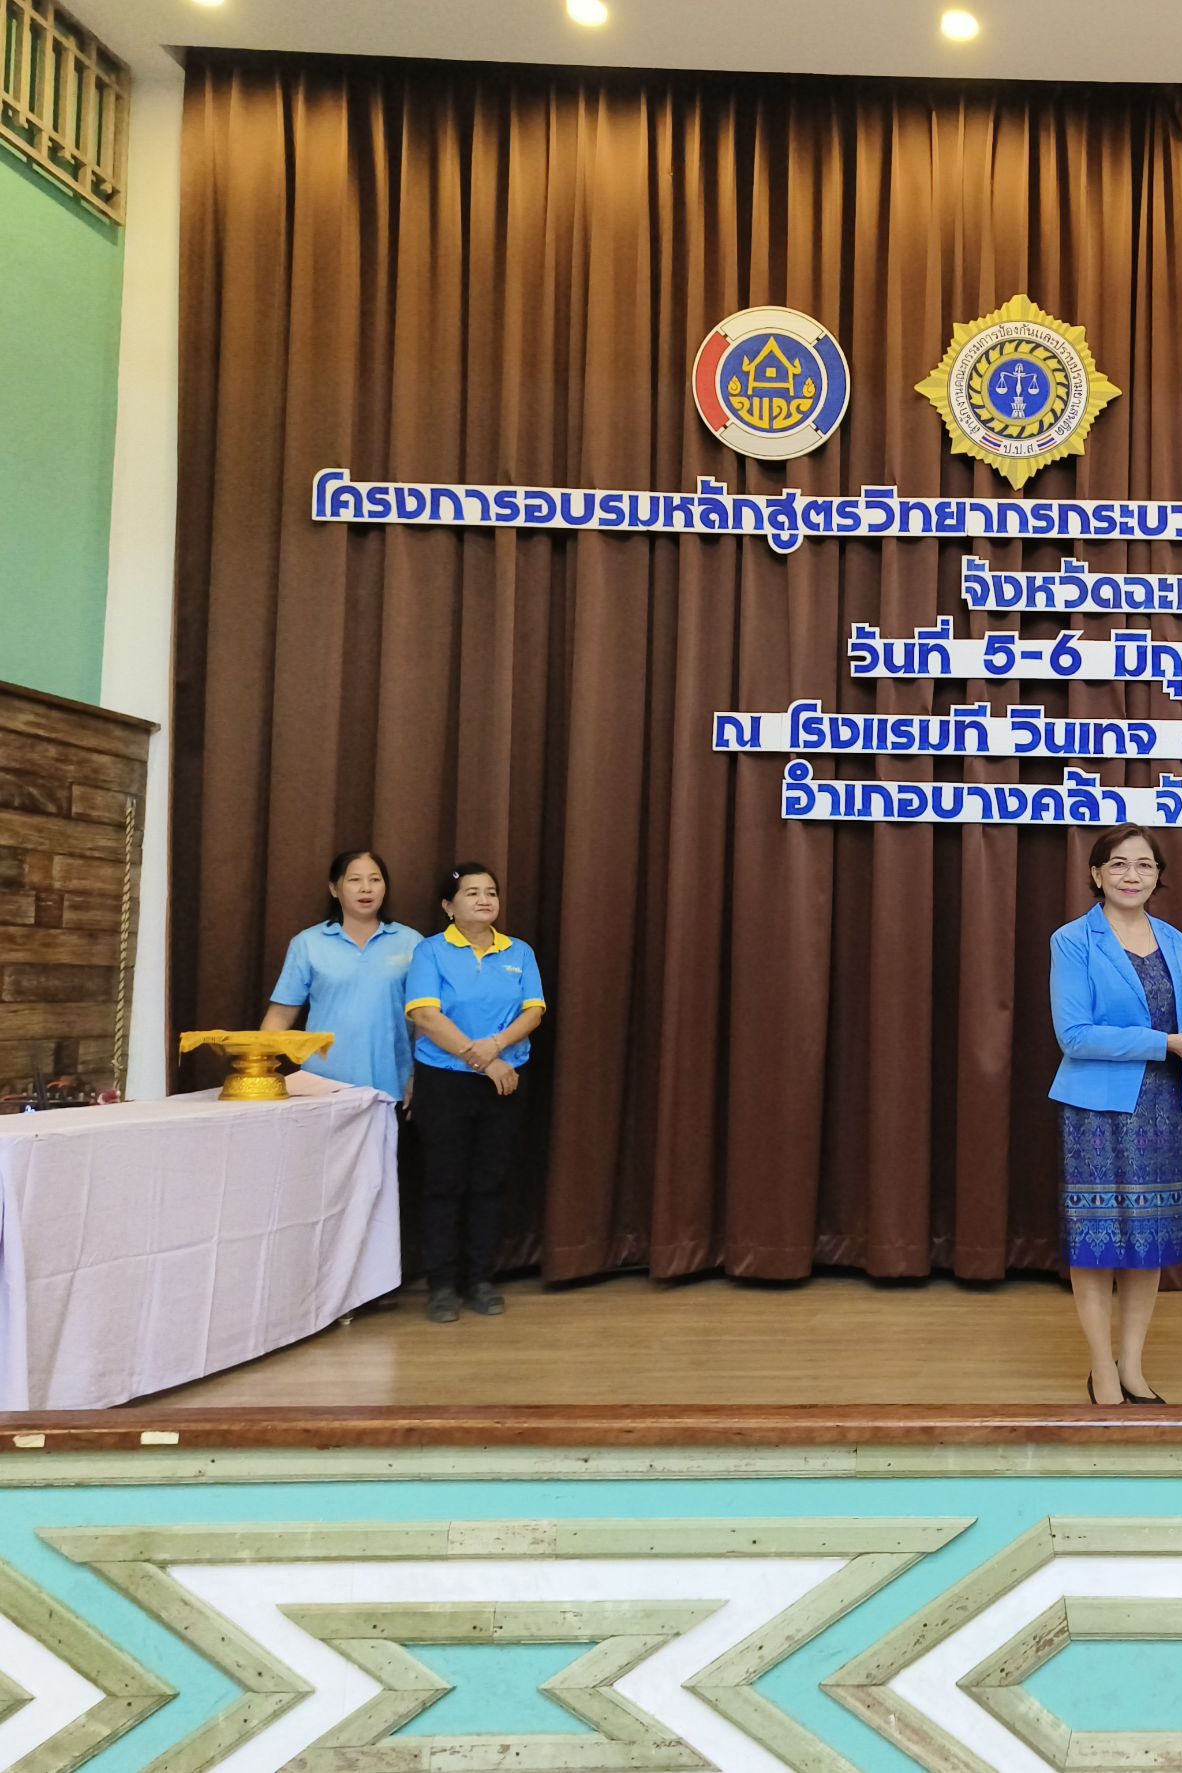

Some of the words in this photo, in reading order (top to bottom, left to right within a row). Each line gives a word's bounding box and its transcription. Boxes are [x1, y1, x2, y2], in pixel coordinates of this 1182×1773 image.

[851, 619, 951, 675] วันที่
[983, 634, 1082, 676] 5-6
[716, 716, 761, 748] ณ
[790, 703, 988, 752] โรงแรมที
[1010, 709, 1157, 755] วินเทจ
[785, 762, 1128, 823] อำเภอบางคล้า
